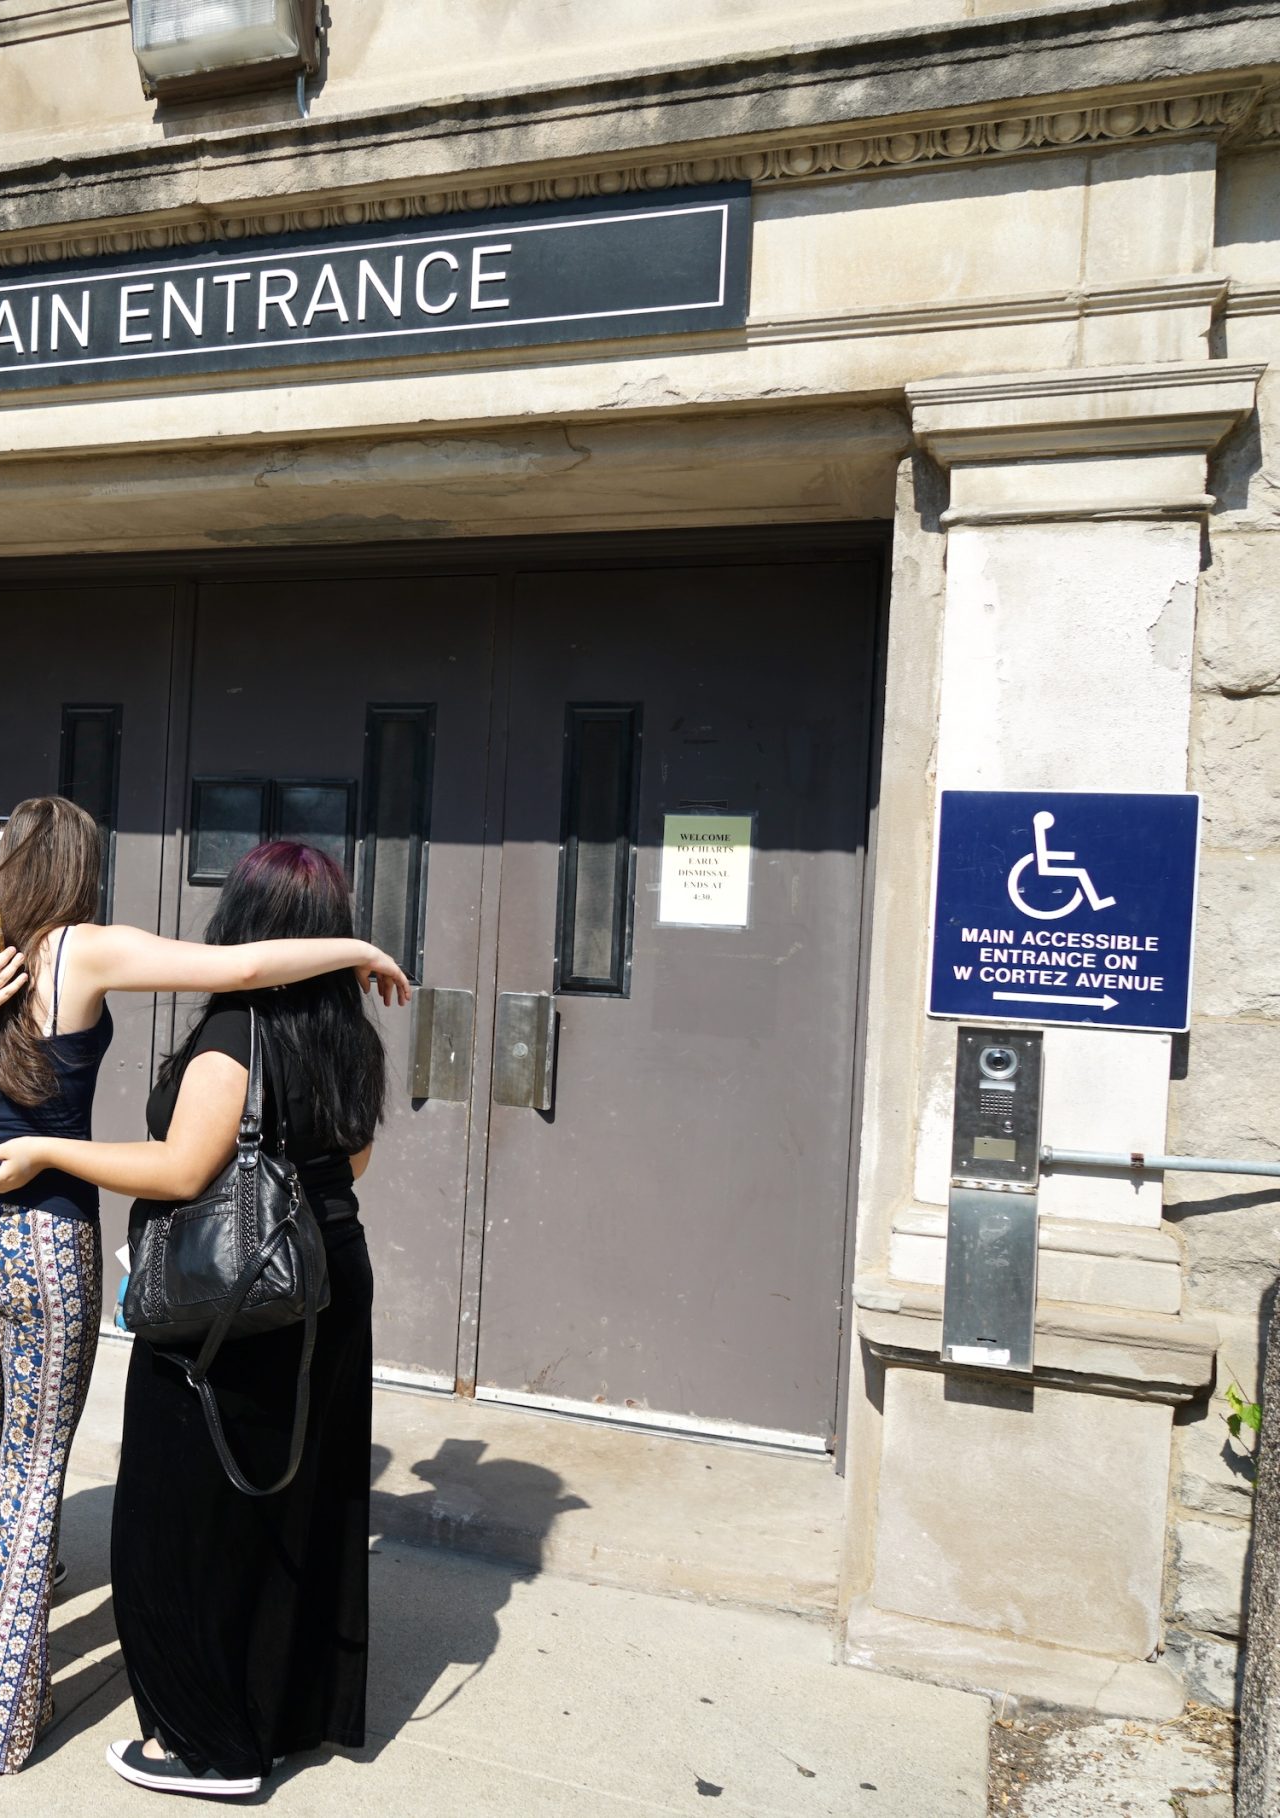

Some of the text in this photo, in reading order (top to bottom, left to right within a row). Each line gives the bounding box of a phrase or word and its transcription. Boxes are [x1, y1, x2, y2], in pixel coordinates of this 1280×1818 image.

[119, 243, 512, 344] ENTRANCE
[680, 833, 732, 842] WELCOME
[677, 845, 690, 853] TO
[688, 857, 720, 865] EARLY
[678, 869, 730, 877] DISMISSAL
[961, 927, 1159, 952] MAIN ACCESSIBLE
[979, 948, 1138, 971] ENTRANCE ON
[953, 965, 1164, 992] W CORTEZ AVENUE
